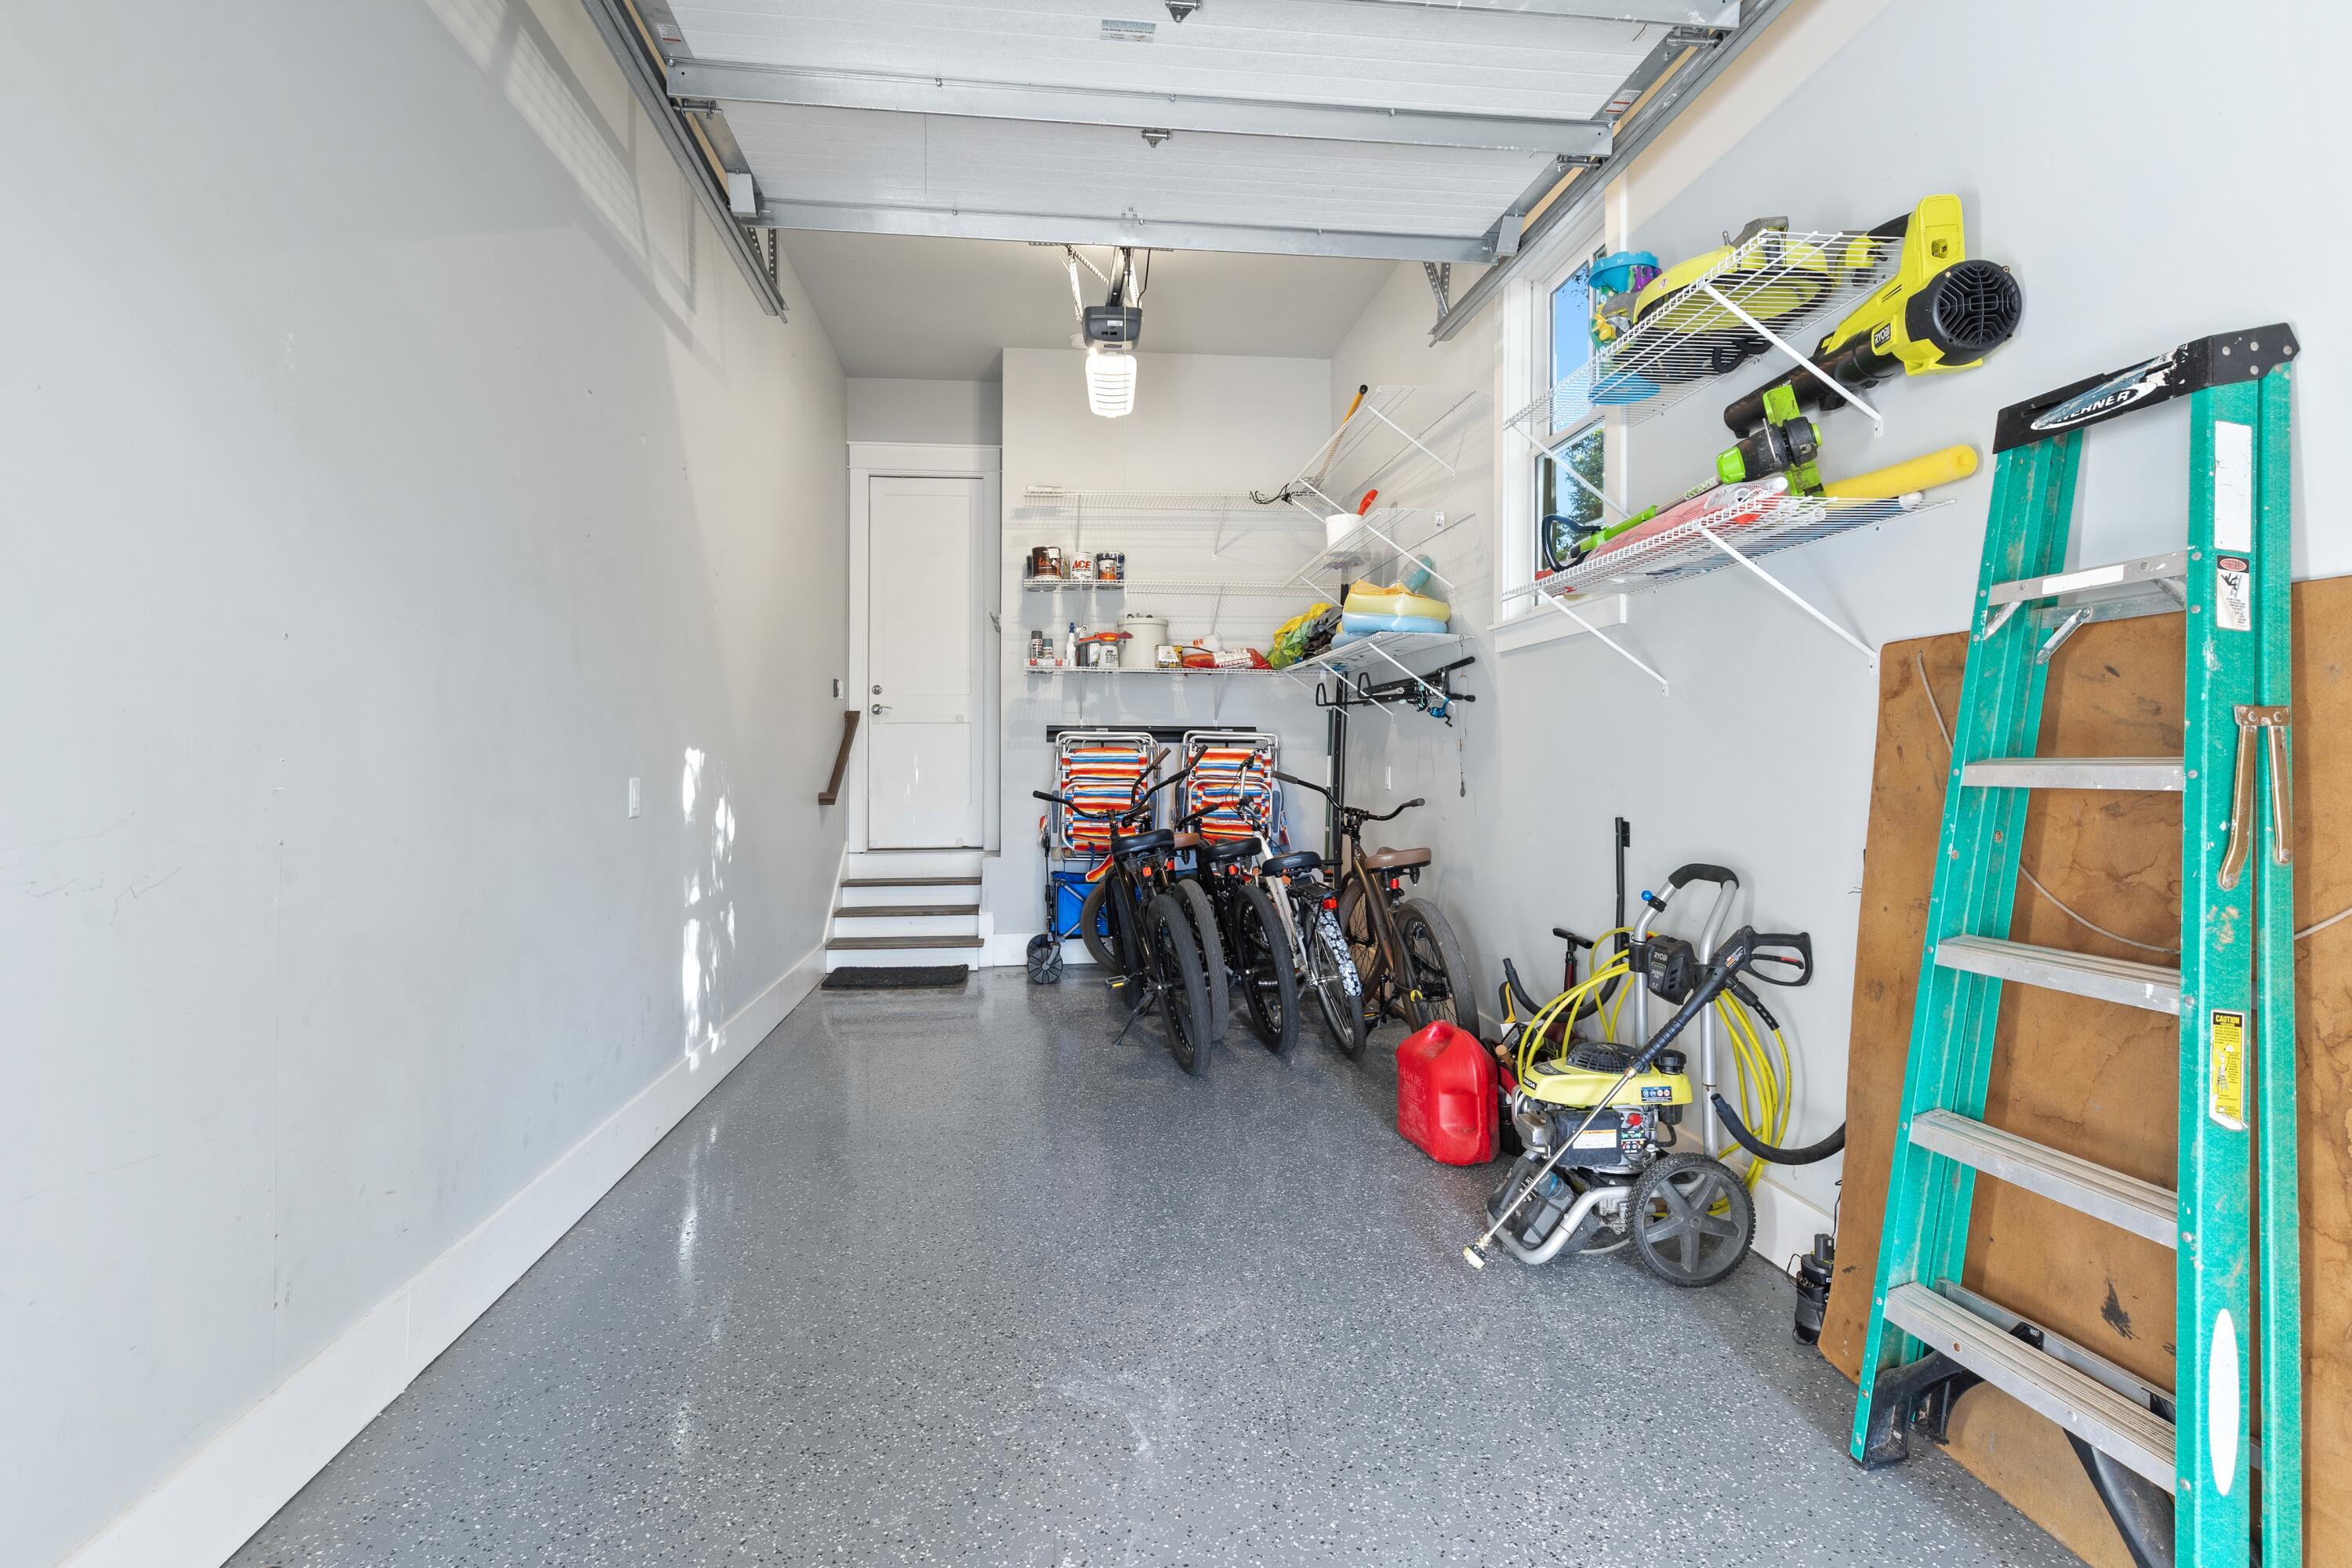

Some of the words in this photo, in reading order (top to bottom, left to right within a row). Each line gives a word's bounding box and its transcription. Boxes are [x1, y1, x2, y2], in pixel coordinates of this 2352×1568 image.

[1875, 325, 1890, 345] RYOBI
[1072, 559, 1091, 569] ACE
[1218, 658, 1251, 668] FIREWOOD
[1653, 952, 1668, 961] RYOBI
[2215, 1014, 2240, 1024] CAUTION
[1538, 1174, 1550, 1185] SOAP
